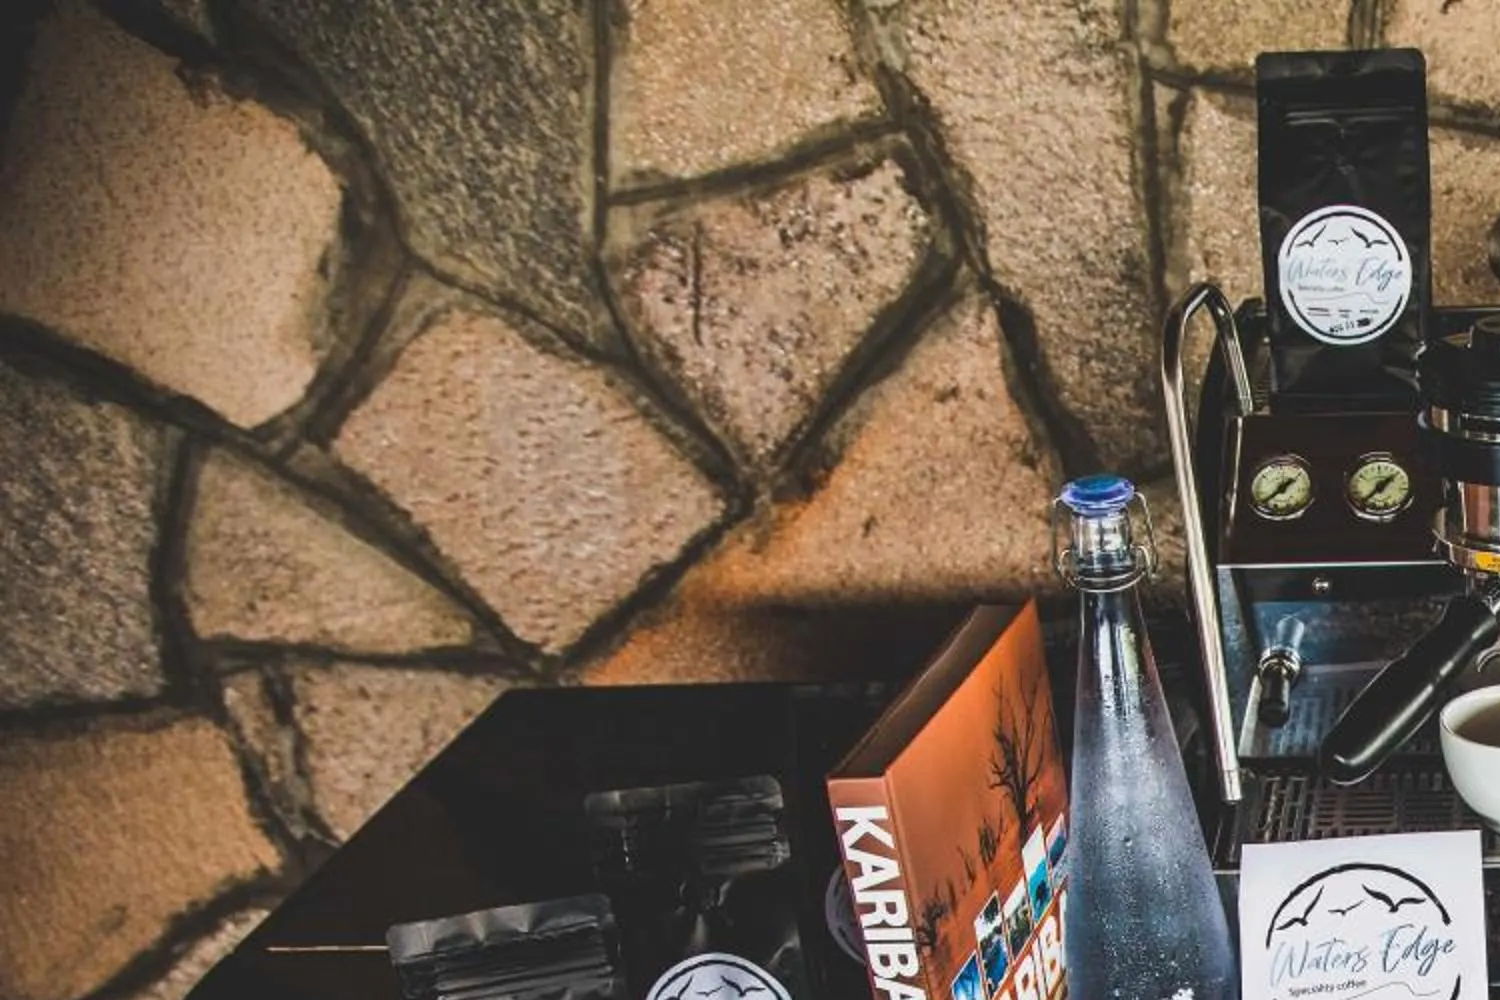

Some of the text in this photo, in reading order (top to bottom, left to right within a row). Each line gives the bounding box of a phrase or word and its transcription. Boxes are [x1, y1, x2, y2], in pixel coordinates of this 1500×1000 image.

[1355, 256, 1402, 291] Edge
[1270, 922, 1458, 988] Waters Edge
